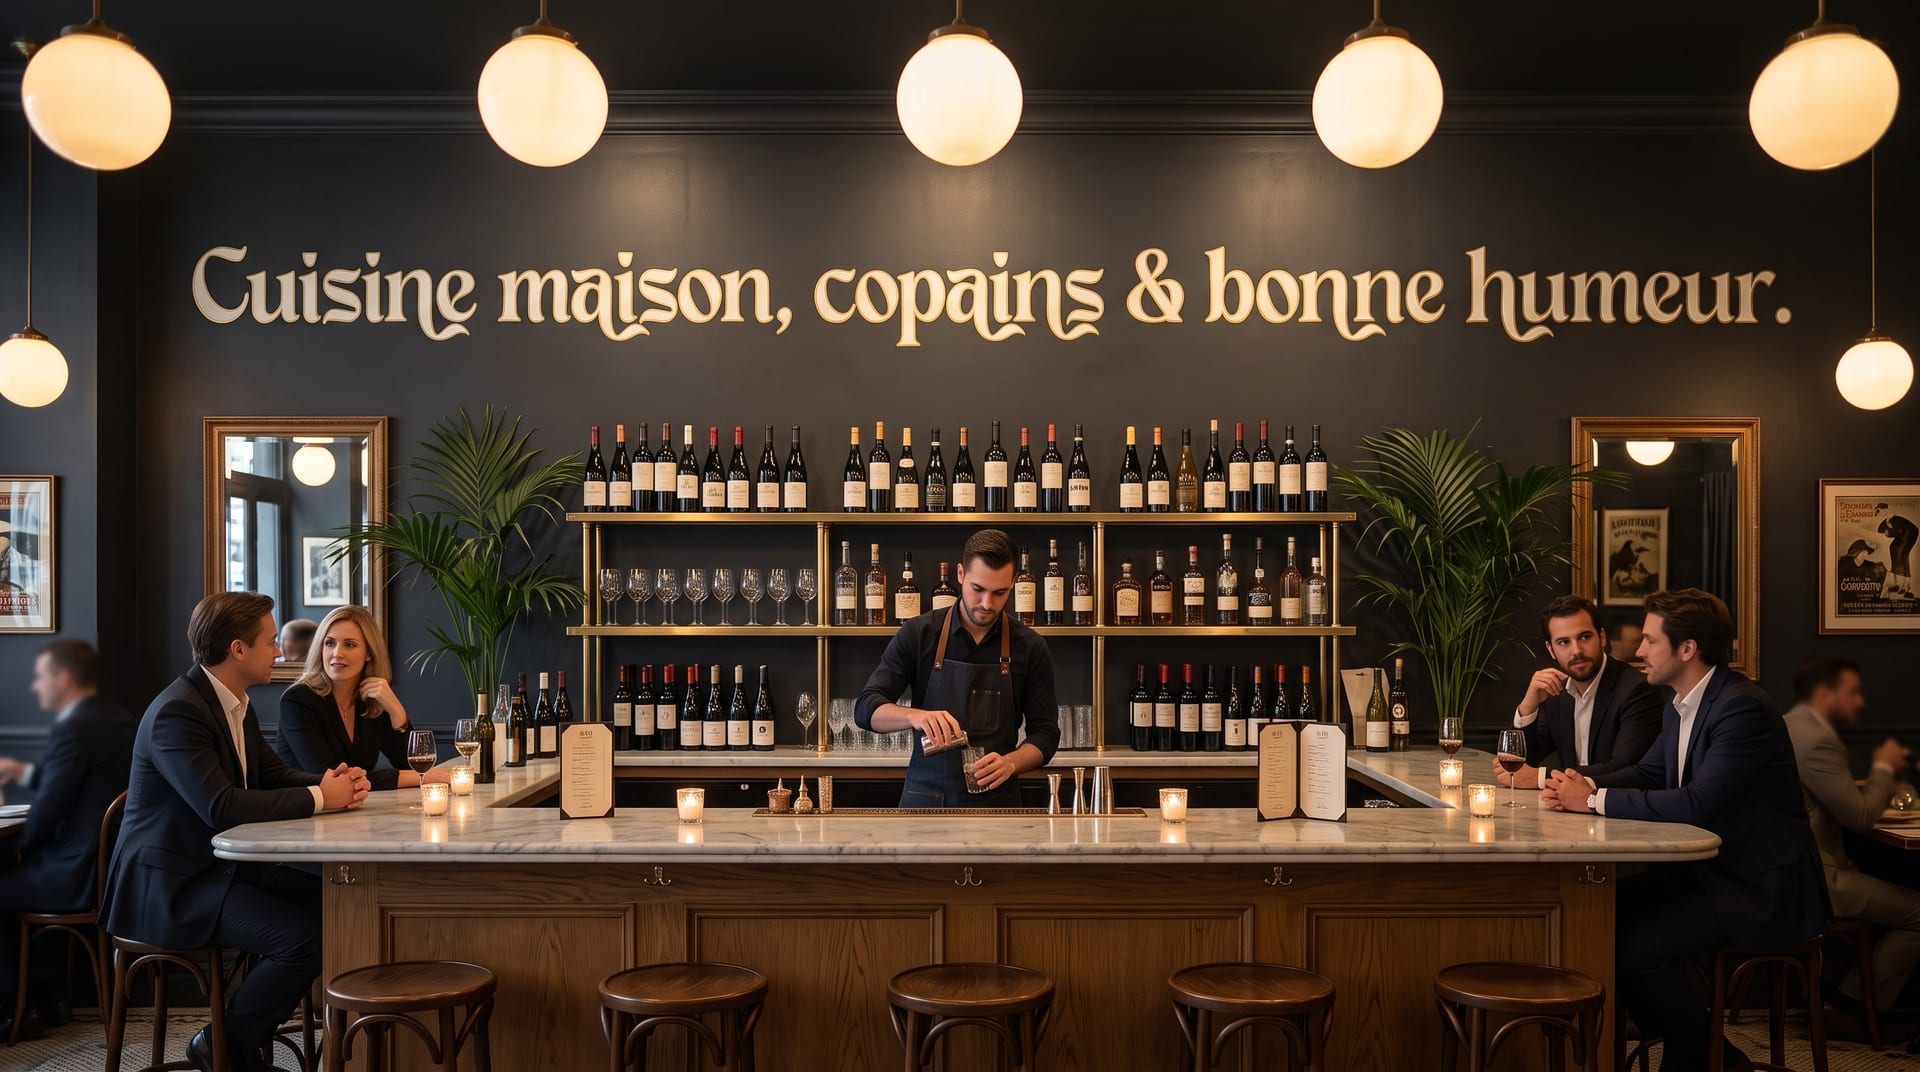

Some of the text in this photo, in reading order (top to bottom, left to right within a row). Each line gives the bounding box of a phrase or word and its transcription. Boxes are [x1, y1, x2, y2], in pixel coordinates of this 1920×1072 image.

[191, 245, 1792, 347] Cuisine maison, copains & bonne humeur.
